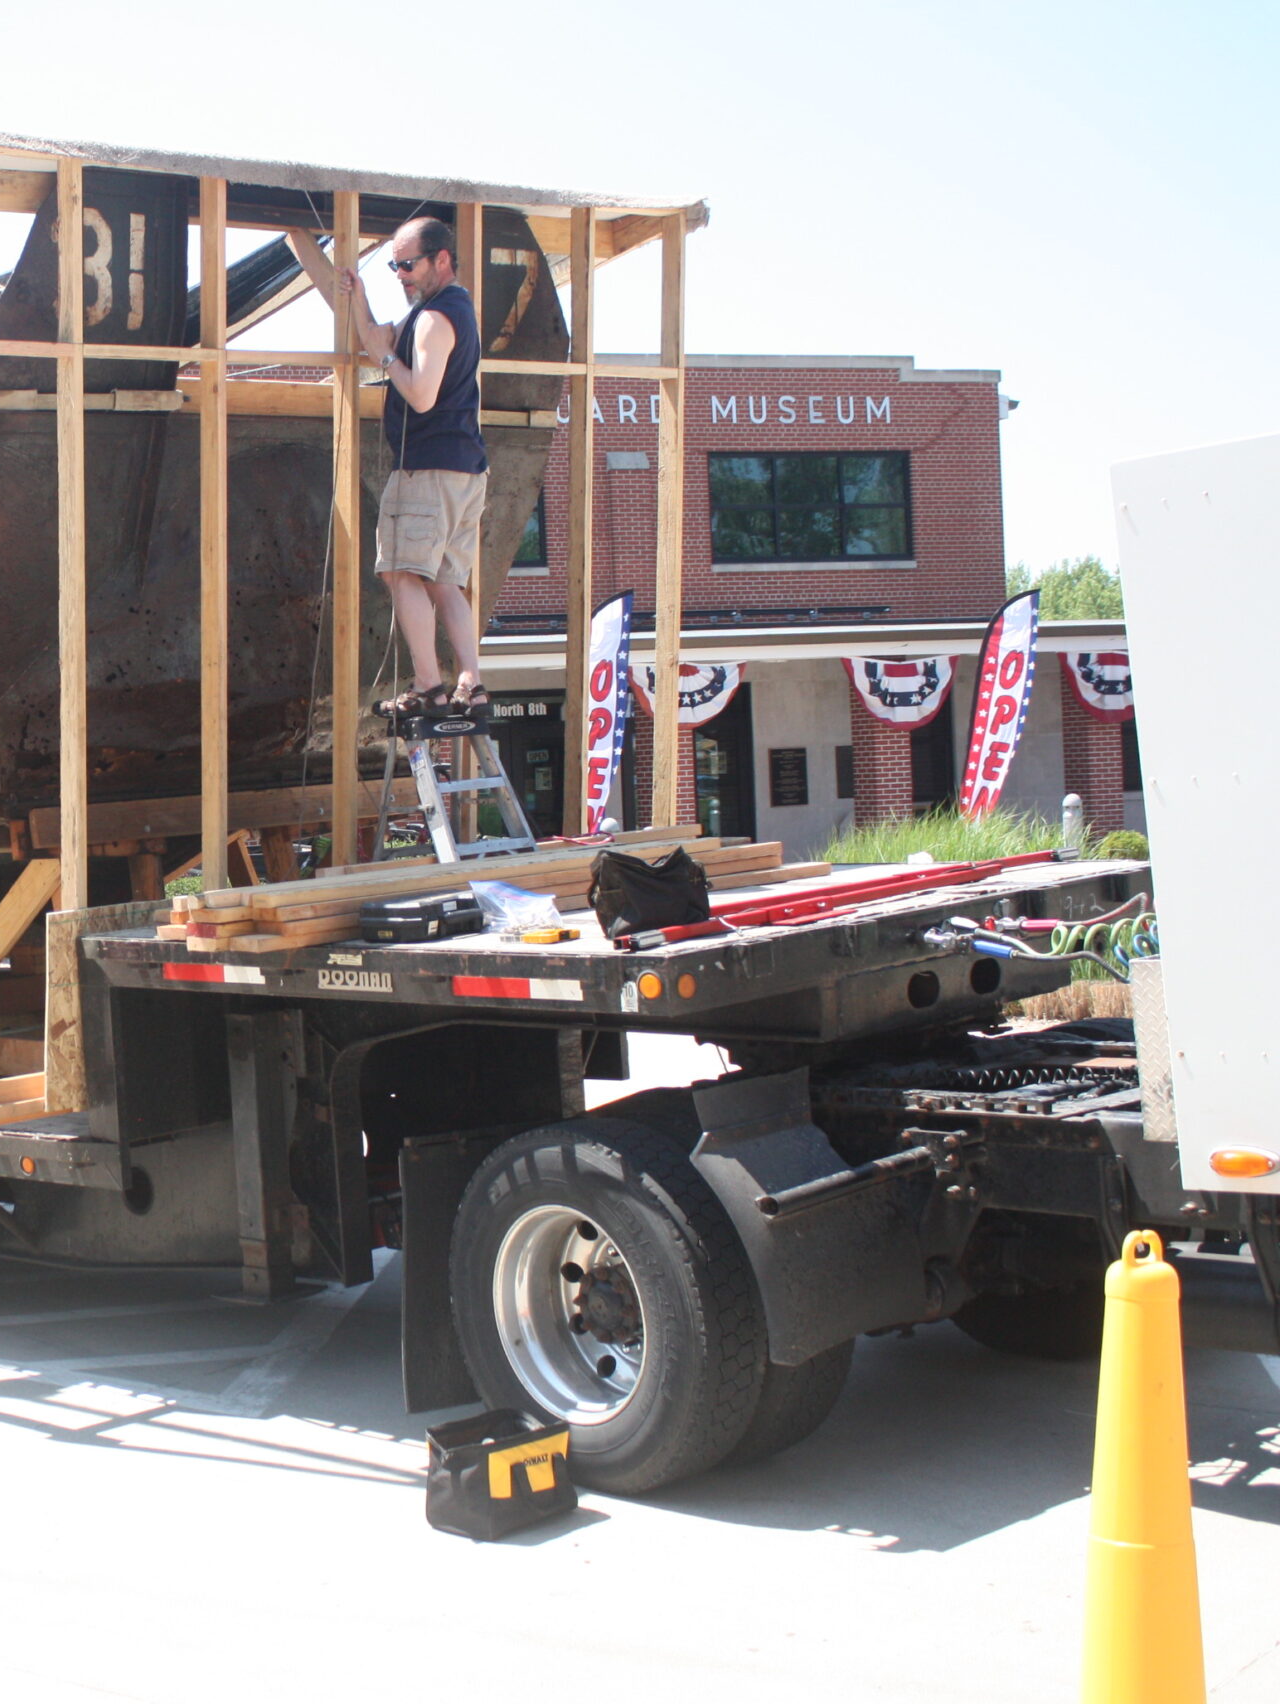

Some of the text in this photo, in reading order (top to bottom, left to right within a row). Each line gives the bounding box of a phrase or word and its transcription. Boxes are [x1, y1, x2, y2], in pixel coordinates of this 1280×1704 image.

[489, 247, 539, 352] 7
[711, 395, 891, 424] MUSEUM
[493, 702, 547, 717] North 8th
[318, 969, 393, 992] DOONAN
